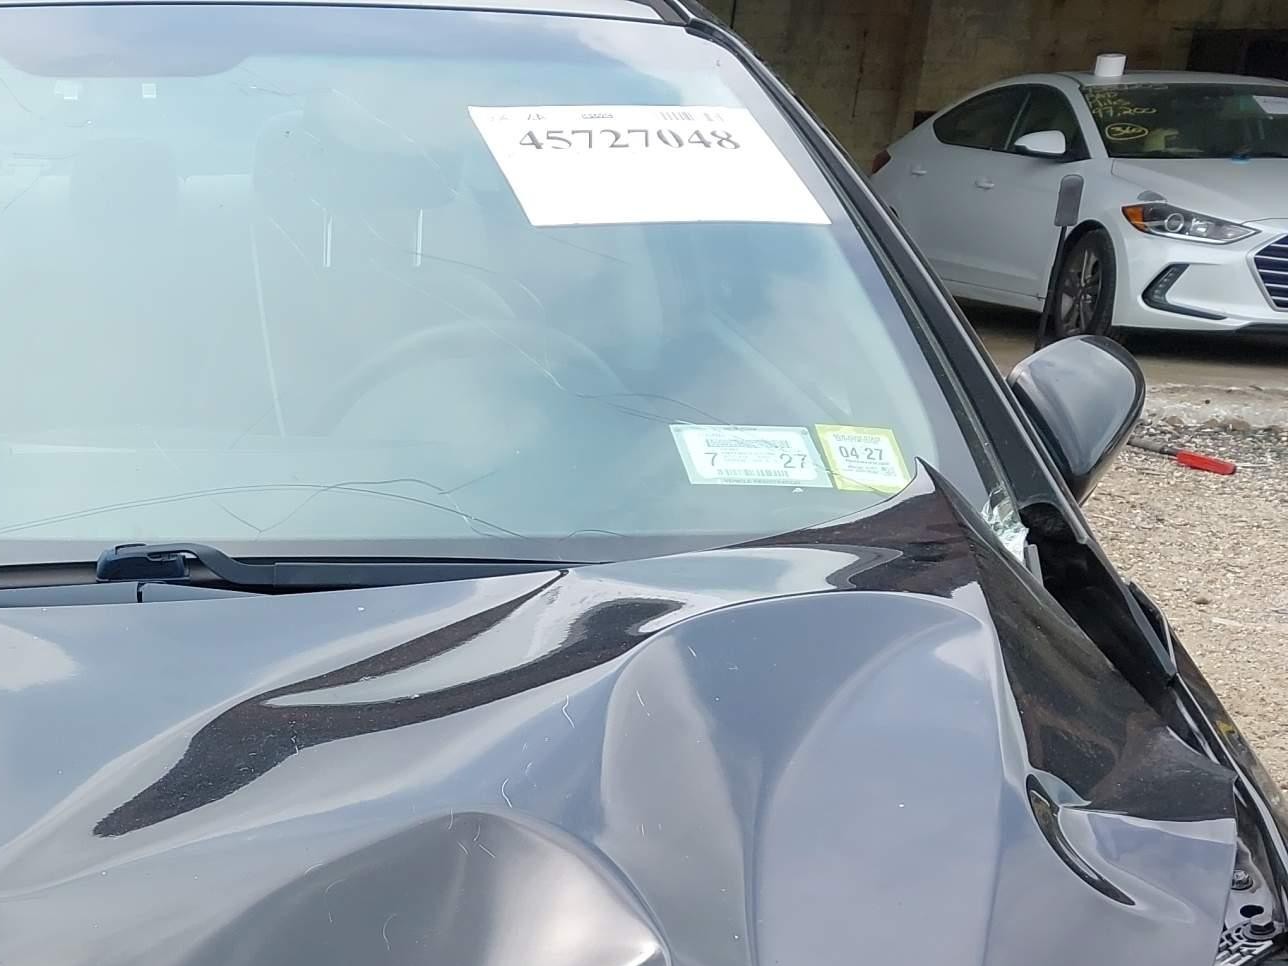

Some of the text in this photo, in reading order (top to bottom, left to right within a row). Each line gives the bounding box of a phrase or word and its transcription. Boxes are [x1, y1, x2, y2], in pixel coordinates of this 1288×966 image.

[519, 129, 741, 150] 45727048
[704, 452, 718, 467] 7
[779, 453, 807, 469] 27
[838, 446, 883, 461] 04 27
